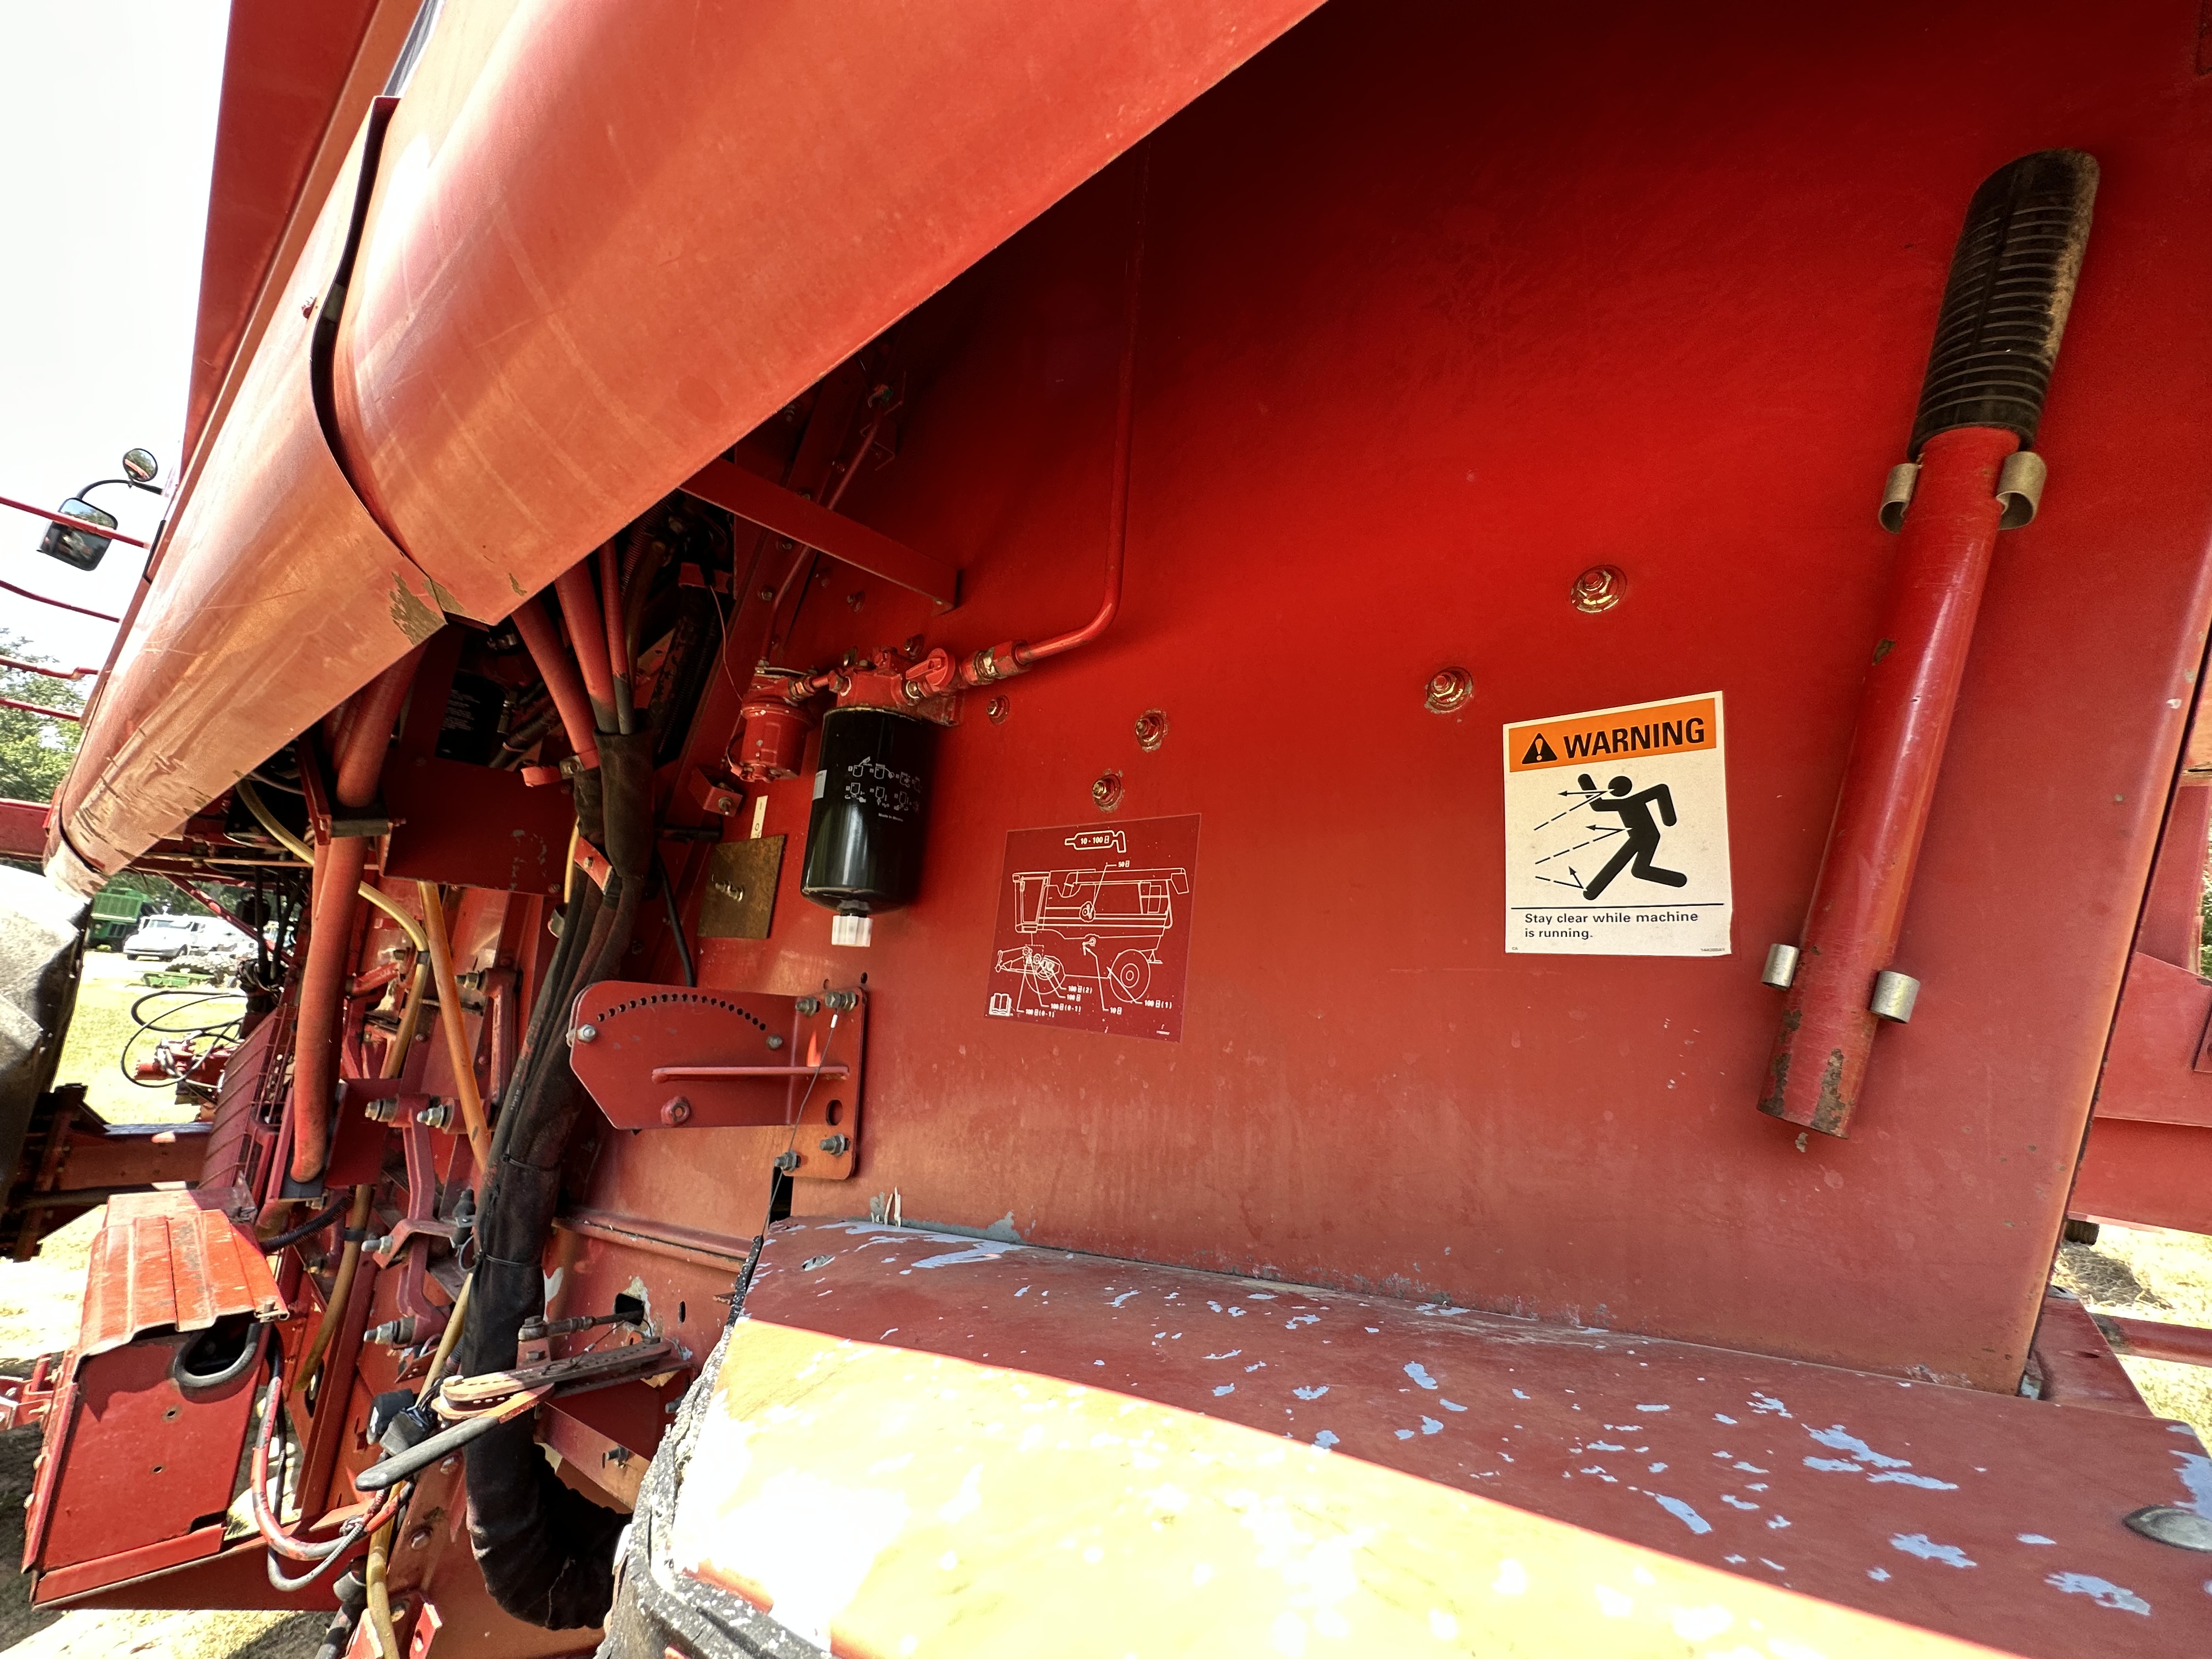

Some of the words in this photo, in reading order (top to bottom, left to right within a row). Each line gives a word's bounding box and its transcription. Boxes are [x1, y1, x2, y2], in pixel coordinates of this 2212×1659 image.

[1564, 718, 1704, 759] WARNING
[1525, 913, 1553, 925] Stay
[1557, 913, 1588, 923] clear
[1593, 912, 1631, 923] while
[1636, 911, 1699, 923] machine
[1525, 928, 1534, 938] is
[1538, 928, 1593, 940] running.
